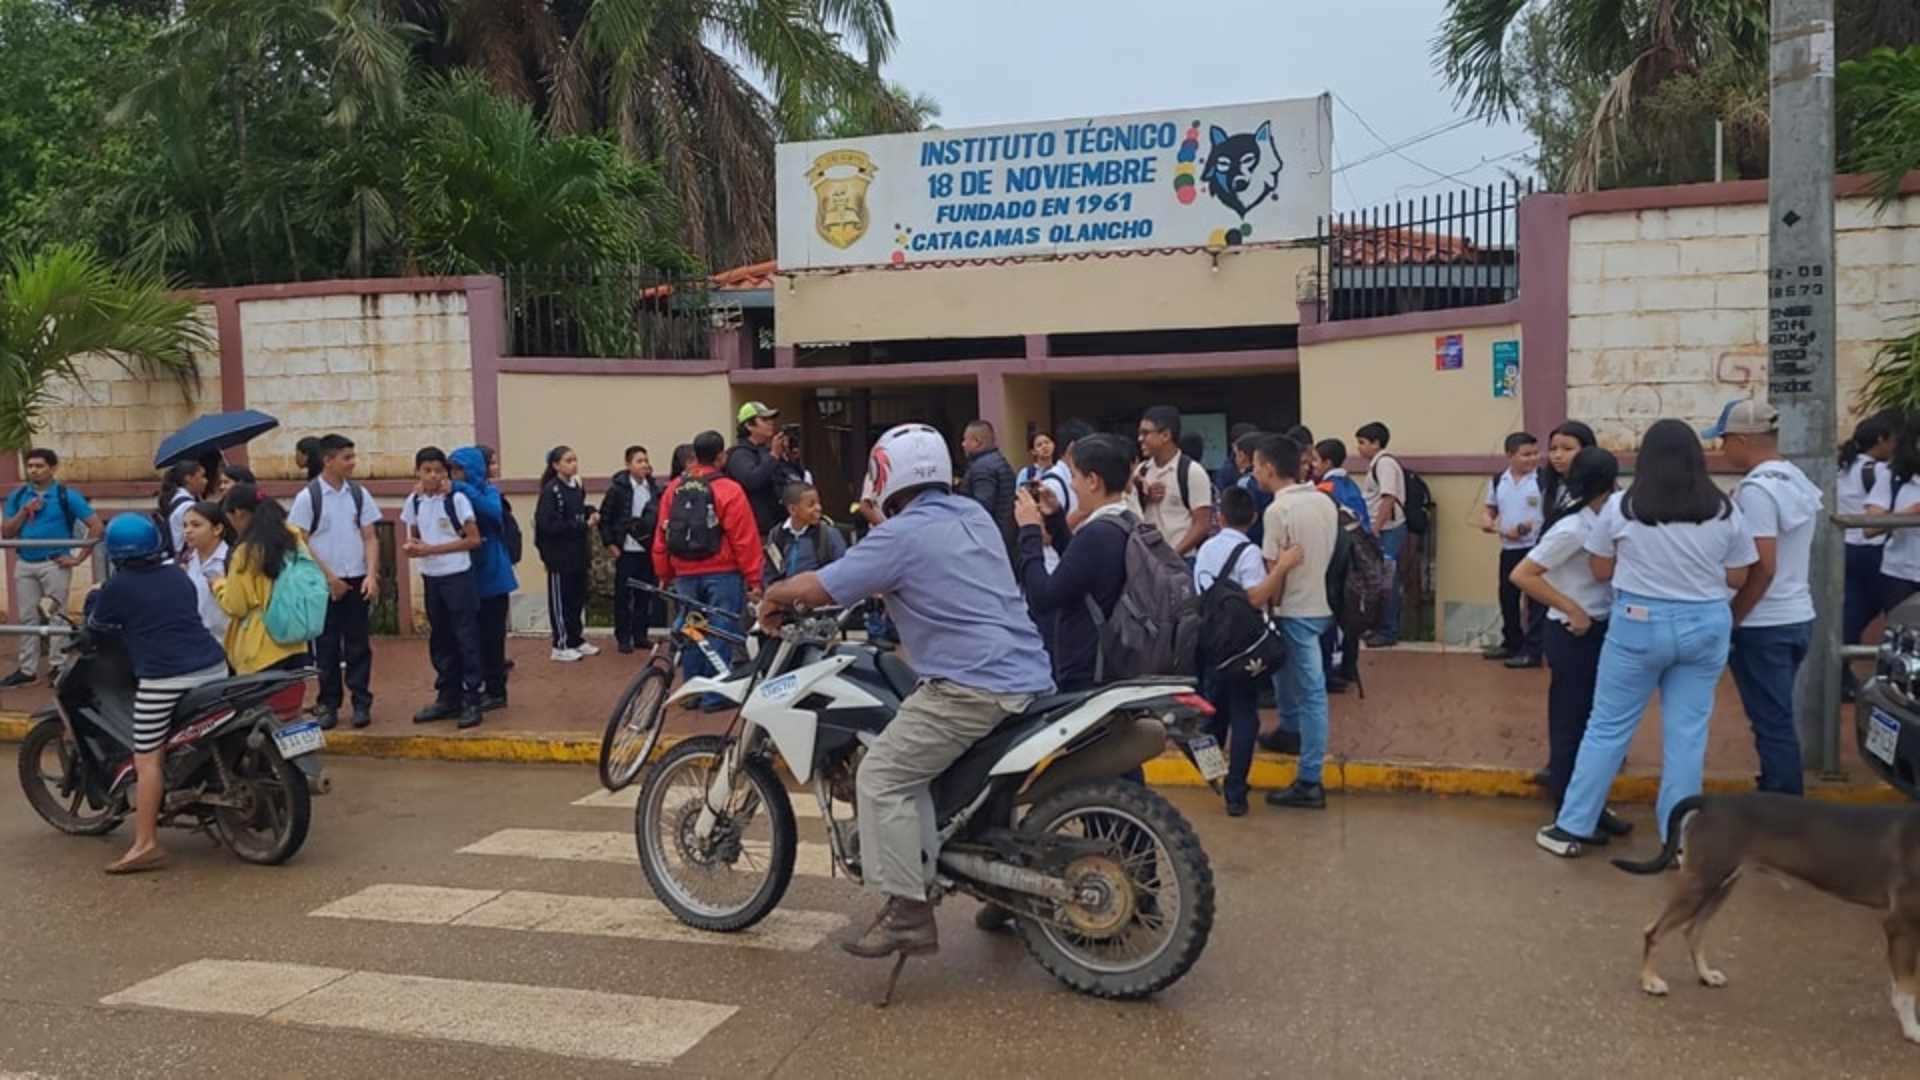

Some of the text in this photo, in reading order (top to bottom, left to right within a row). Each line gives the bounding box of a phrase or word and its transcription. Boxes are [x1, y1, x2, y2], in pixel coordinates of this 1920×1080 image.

[920, 119, 1177, 167] INSTITUTO TÉCNICO
[927, 157, 1157, 199] 18 DE NOVIEMBRE
[936, 192, 1132, 224] FUNDADO EN 1961
[912, 218, 1153, 251] CATACAMAS OLANCHO
